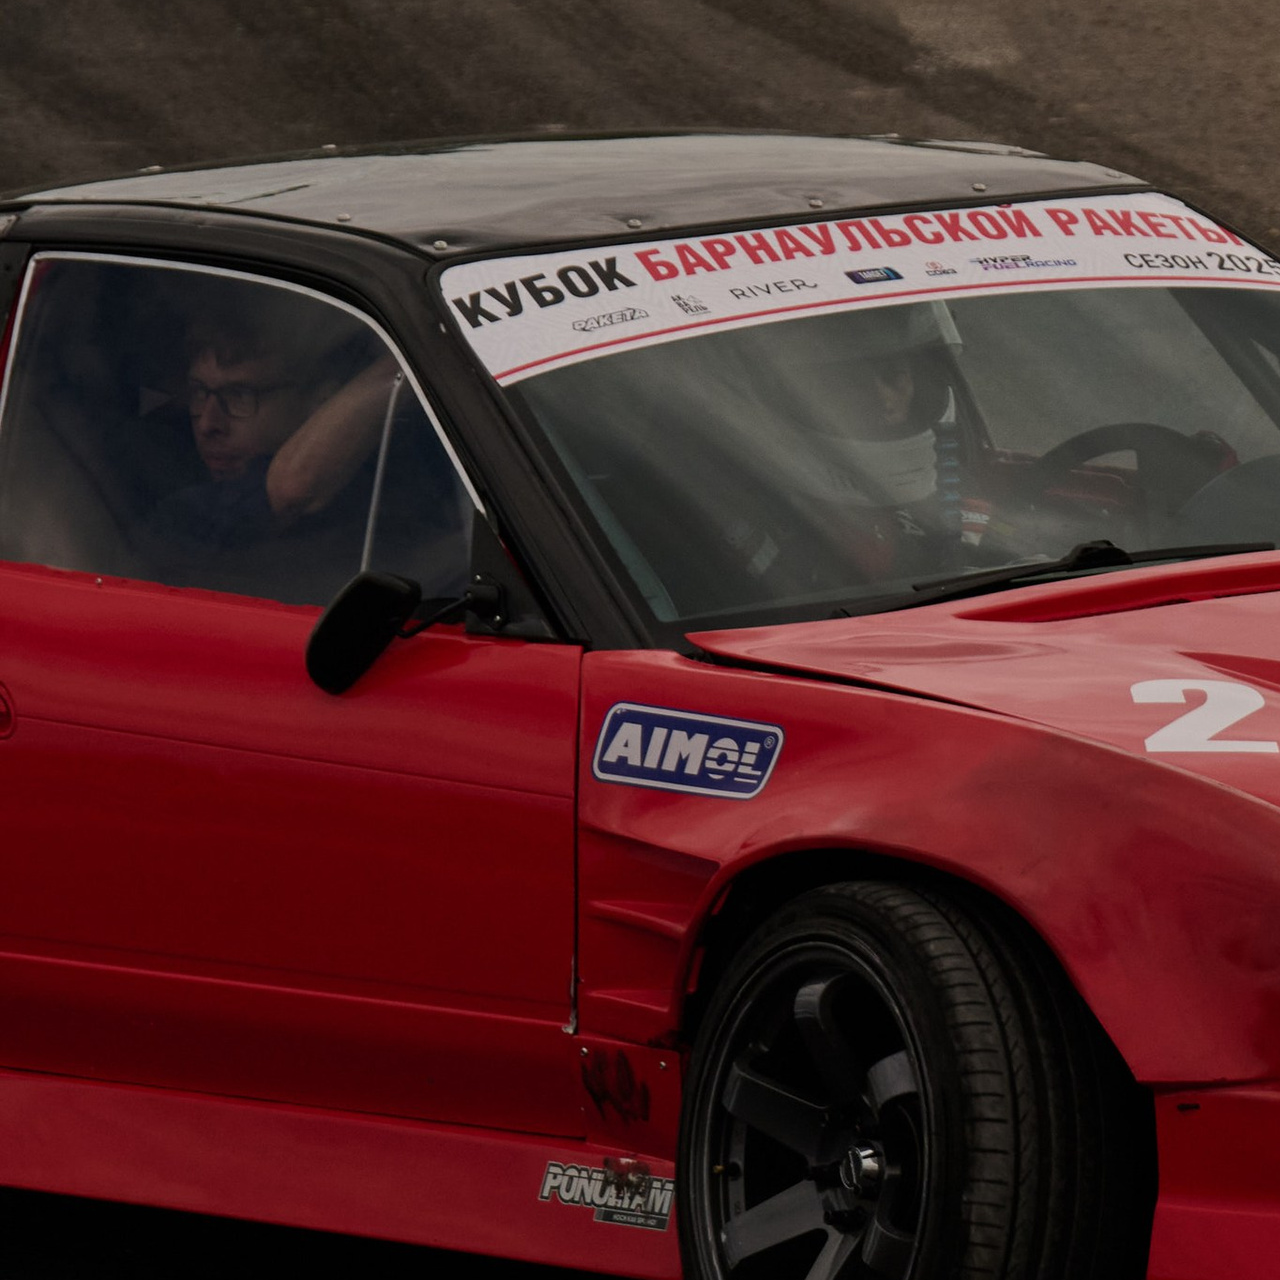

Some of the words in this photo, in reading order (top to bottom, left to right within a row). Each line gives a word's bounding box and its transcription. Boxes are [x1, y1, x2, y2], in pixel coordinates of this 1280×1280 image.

[452, 256, 638, 328] КУБОК
[634, 204, 1042, 281] БАРНАУЛЬСКОЙ
[1044, 207, 1246, 246] РАКЕТЫ
[1123, 252, 1208, 270] СЕЗОН
[729, 278, 818, 300] RIVER
[602, 721, 762, 784] AIMOL
